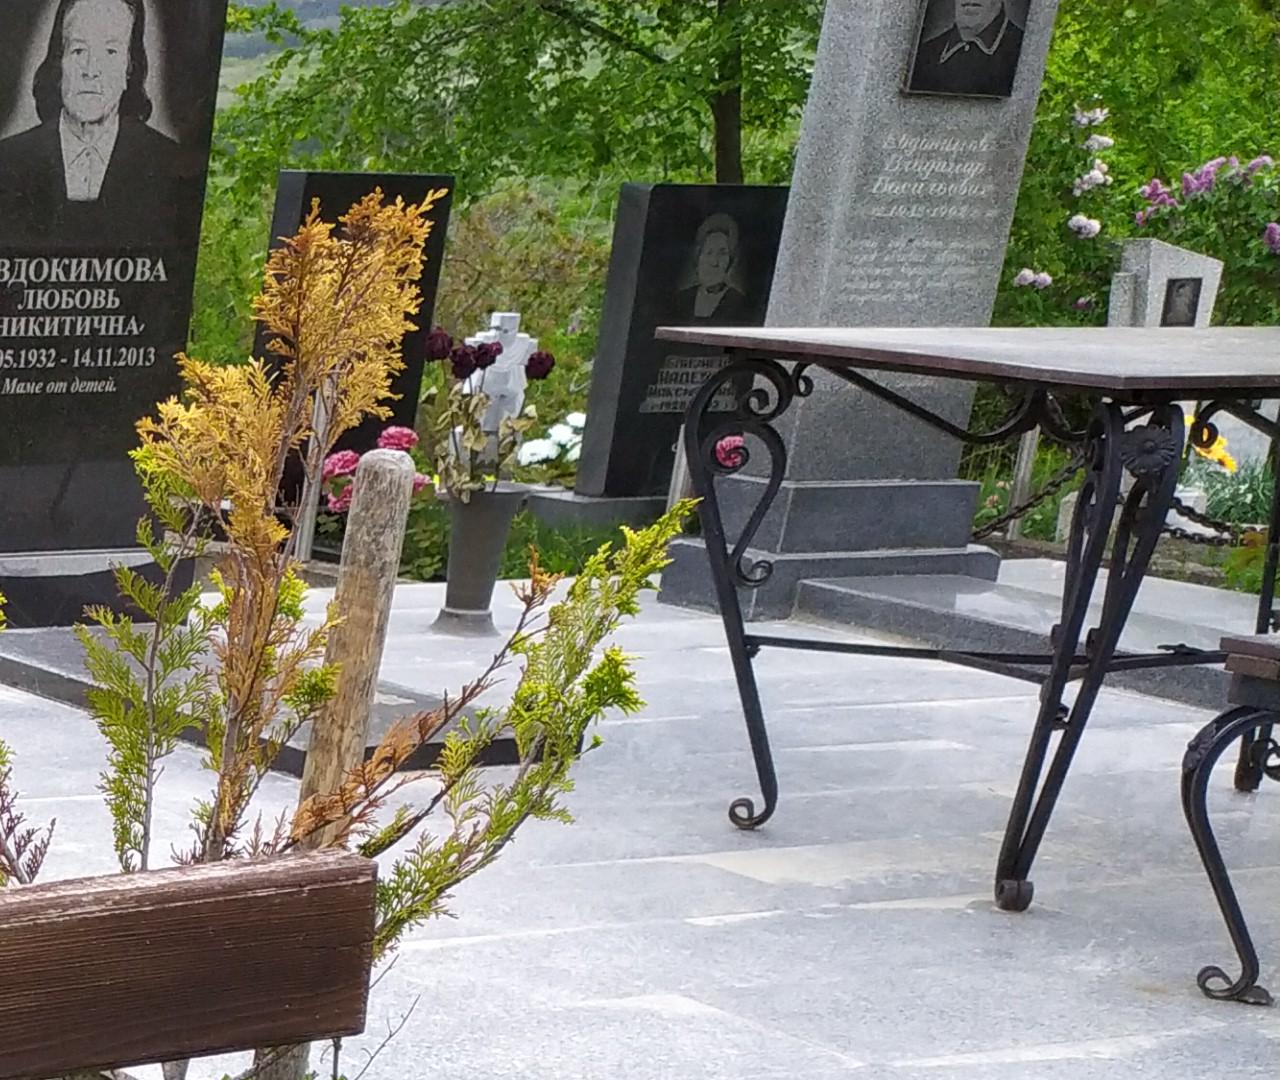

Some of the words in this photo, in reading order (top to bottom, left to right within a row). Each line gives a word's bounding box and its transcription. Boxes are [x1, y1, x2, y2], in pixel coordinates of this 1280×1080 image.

[17, 289, 121, 311] ЛЮБОВЬ
[72, 347, 156, 368] 14.11.2013
[1, 378, 42, 395] Маме
[46, 381, 67, 394] от
[70, 376, 117, 394] детей.
